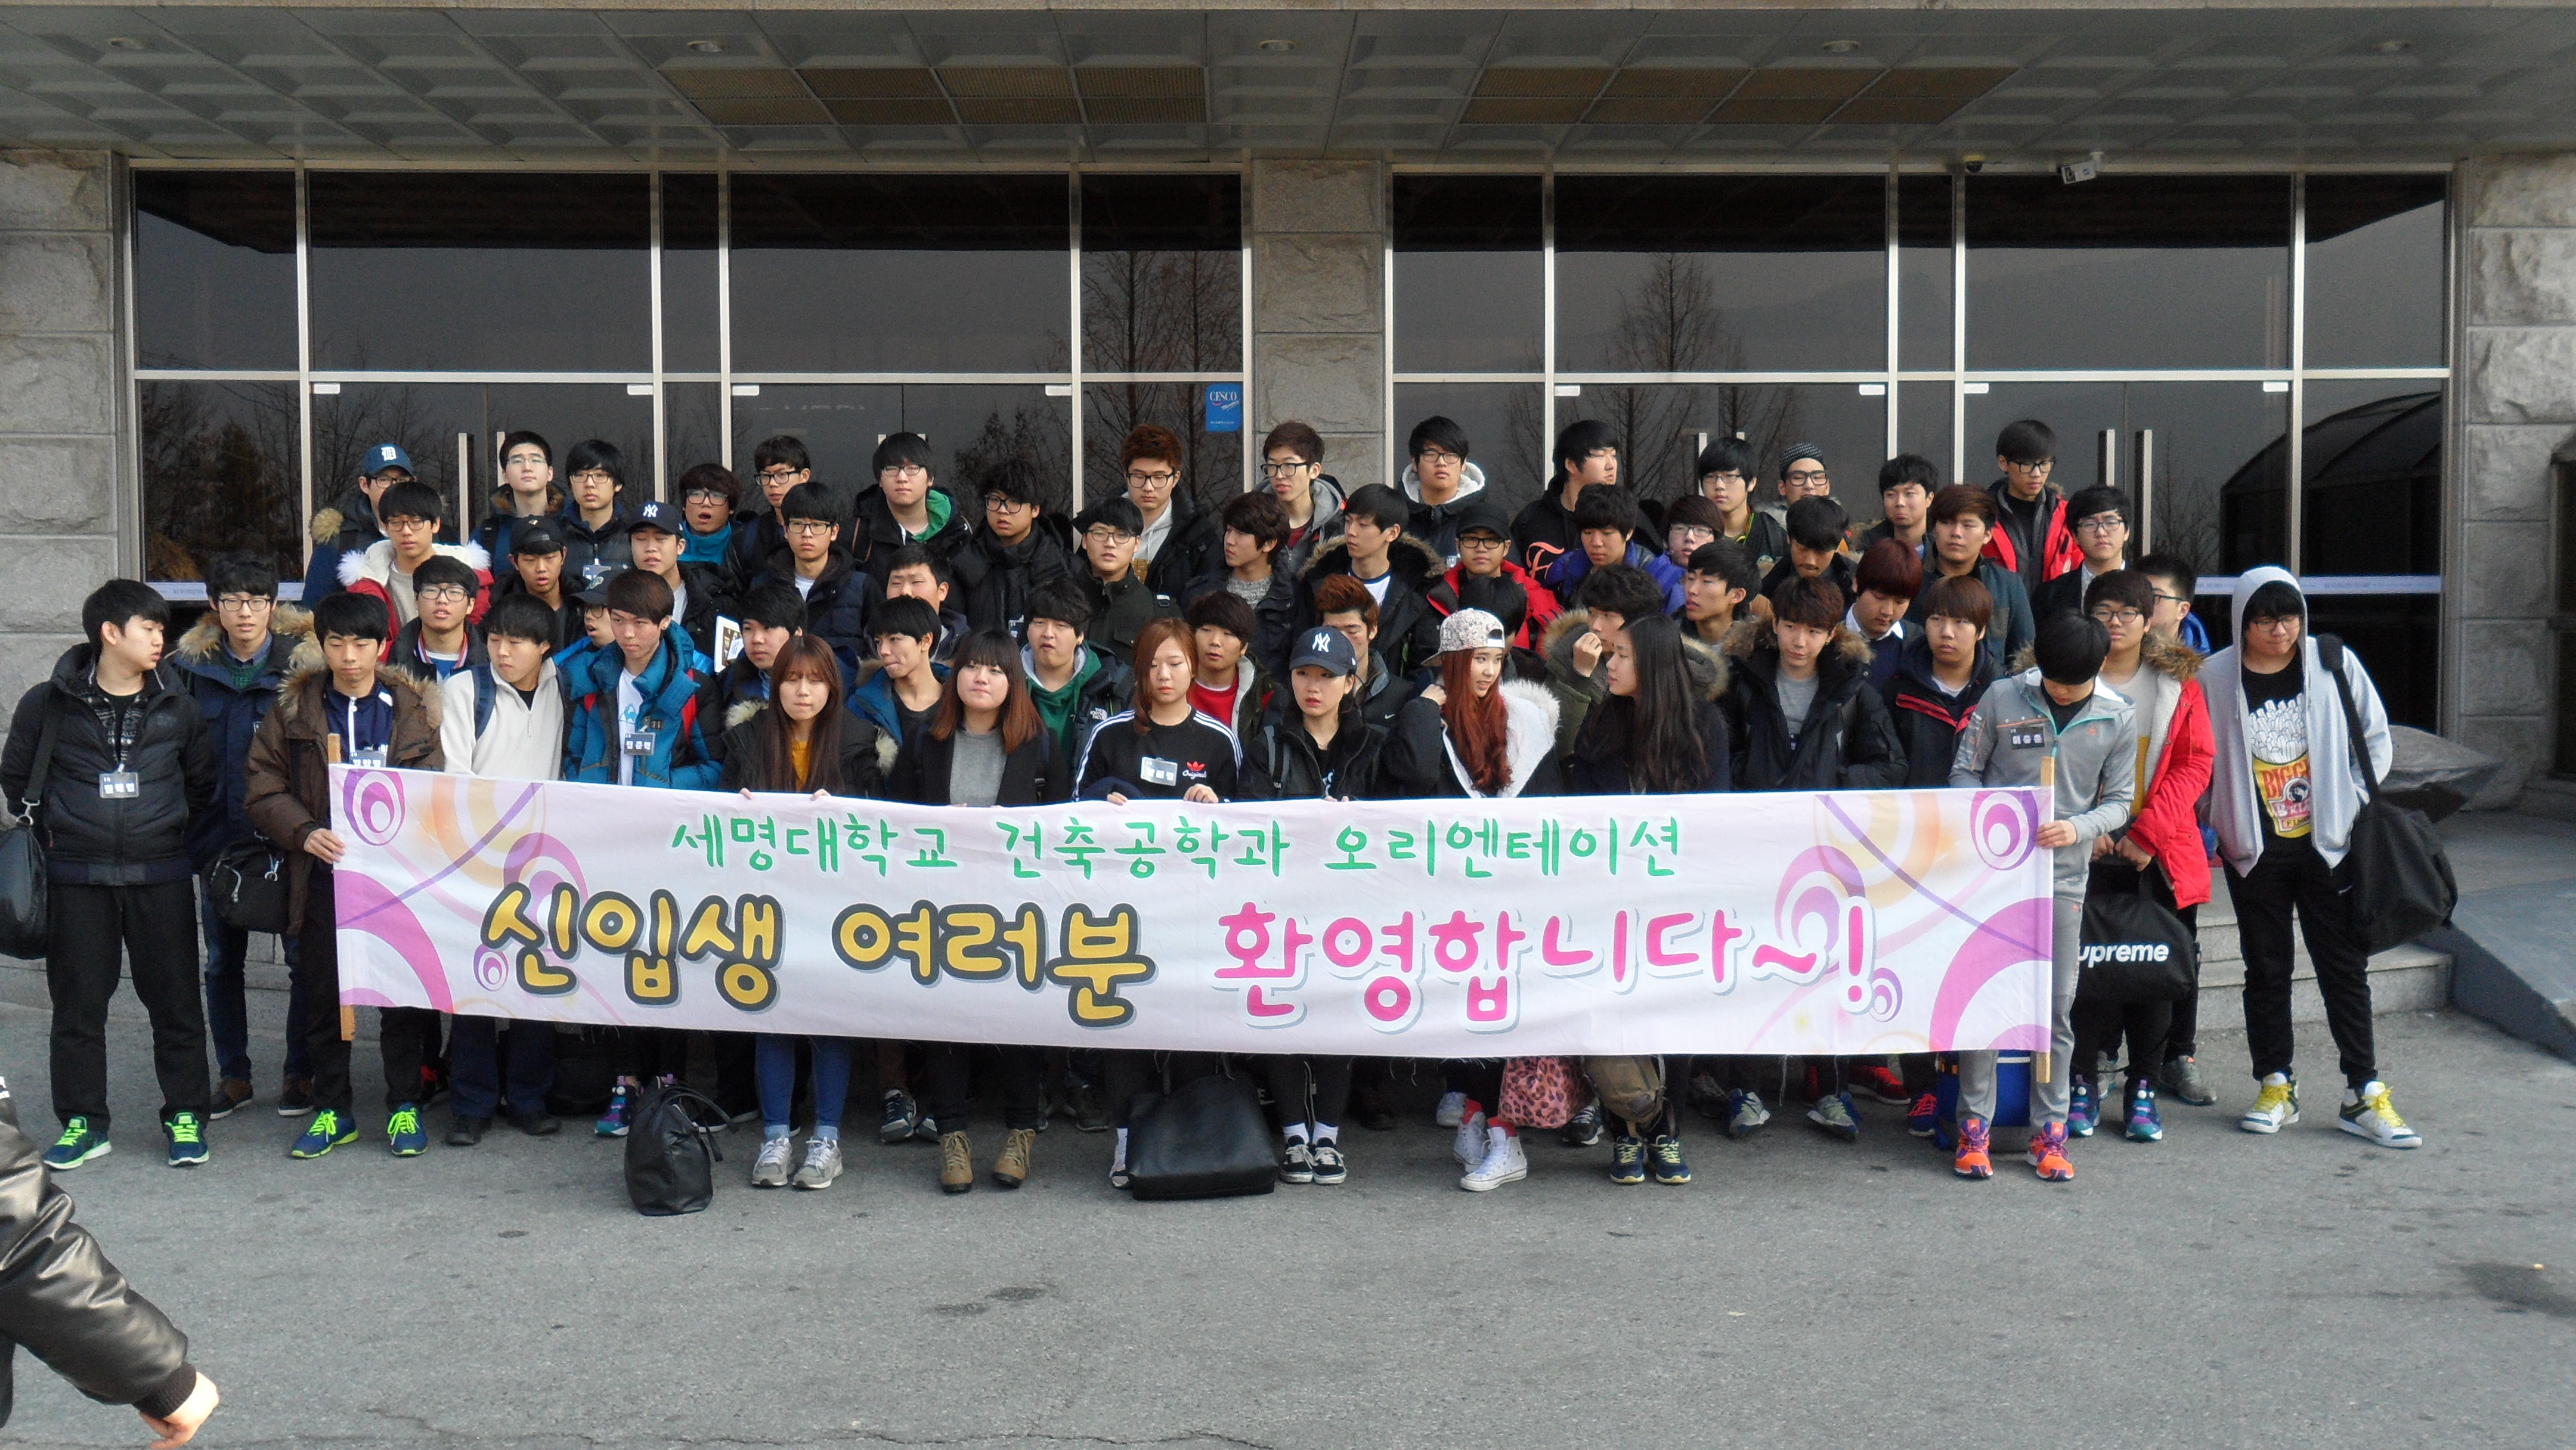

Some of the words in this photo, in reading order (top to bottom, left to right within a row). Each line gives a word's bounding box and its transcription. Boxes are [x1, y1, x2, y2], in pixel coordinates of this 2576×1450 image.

[1312, 632, 1330, 653] NY
[672, 814, 958, 875] 세명대학교
[998, 816, 1290, 879] 건축공학과
[1327, 819, 1679, 878] 오리엔테이션
[479, 881, 784, 1013] 신입생
[833, 899, 1157, 1028] 여러분
[1212, 900, 1866, 1024] 환영합니다~!
[2078, 944, 2169, 968] upreme
